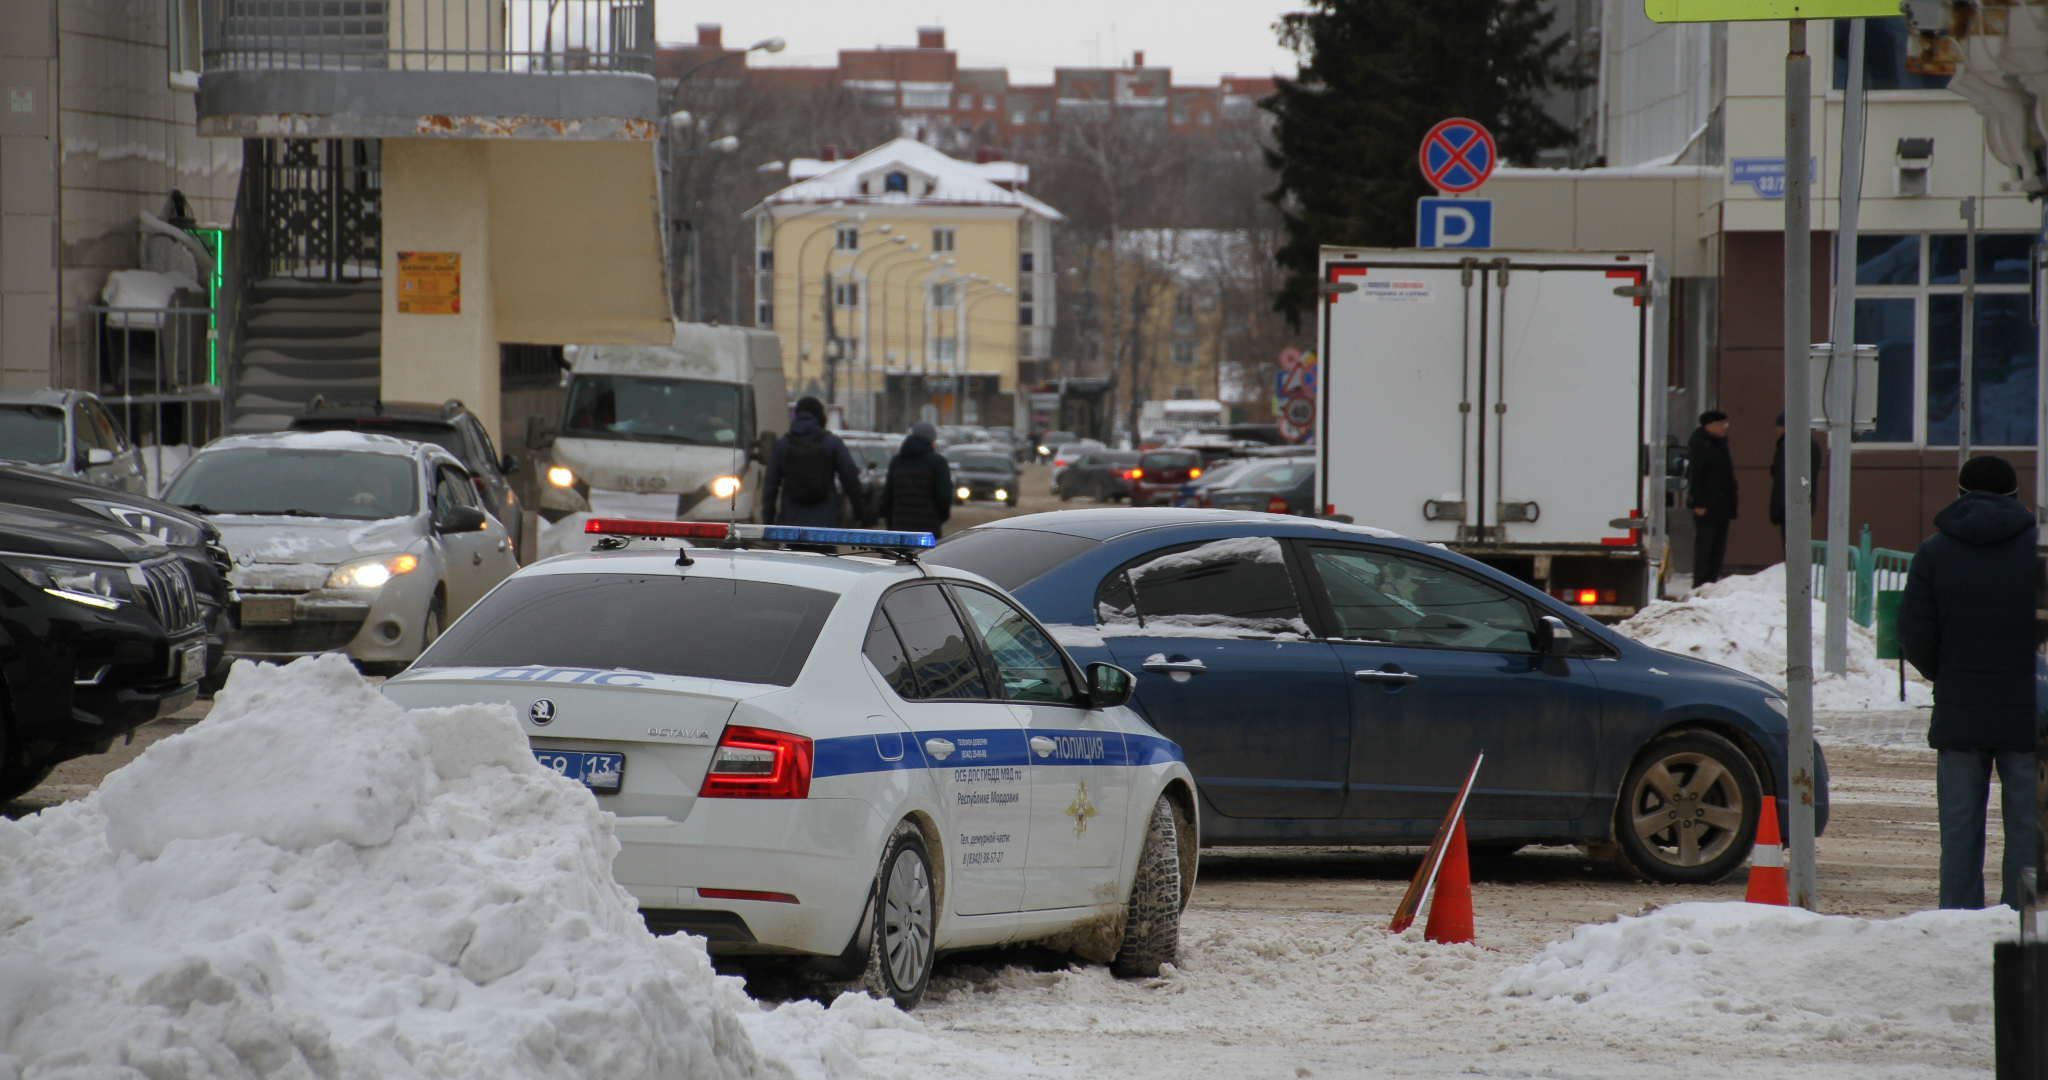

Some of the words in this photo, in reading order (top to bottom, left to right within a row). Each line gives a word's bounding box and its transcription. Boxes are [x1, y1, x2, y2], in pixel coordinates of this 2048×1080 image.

[1435, 206, 1475, 247] P
[473, 668, 655, 687] ДПС
[647, 727, 710, 740] OCTAVIA
[1053, 736, 1104, 764] ПОЛИЦИЯ
[586, 756, 611, 774] 13
[954, 769, 967, 783] ОСБ
[967, 768, 980, 784] ДПС
[980, 768, 1000, 783] ГИБДД
[1001, 767, 1014, 783] МВД
[1014, 770, 1022, 781] по
[957, 791, 990, 807] Республике
[970, 831, 996, 847] дежурной
[966, 852, 983, 867] (8342)
